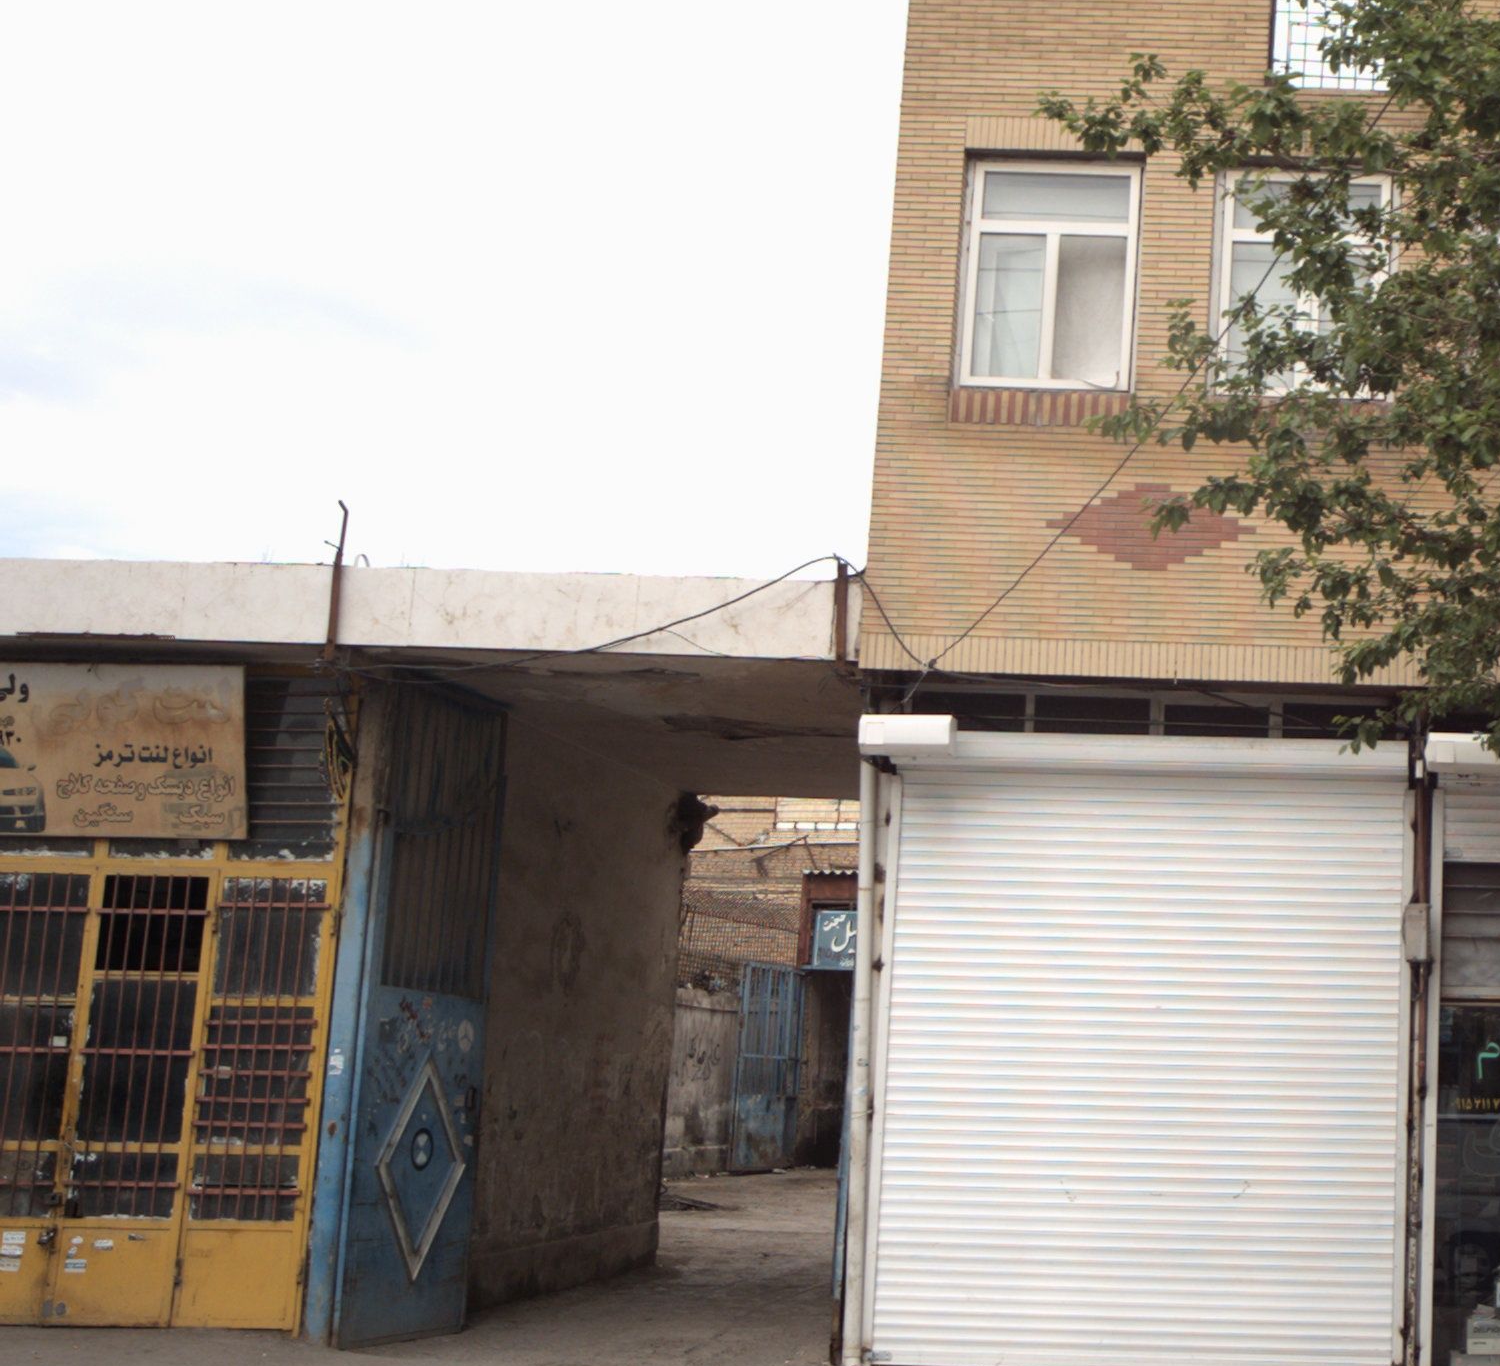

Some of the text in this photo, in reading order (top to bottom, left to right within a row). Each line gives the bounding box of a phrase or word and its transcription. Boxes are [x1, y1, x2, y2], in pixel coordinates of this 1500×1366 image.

[92, 743, 213, 769] انواع لنت ترمز
[194, 775, 237, 803] انواع
